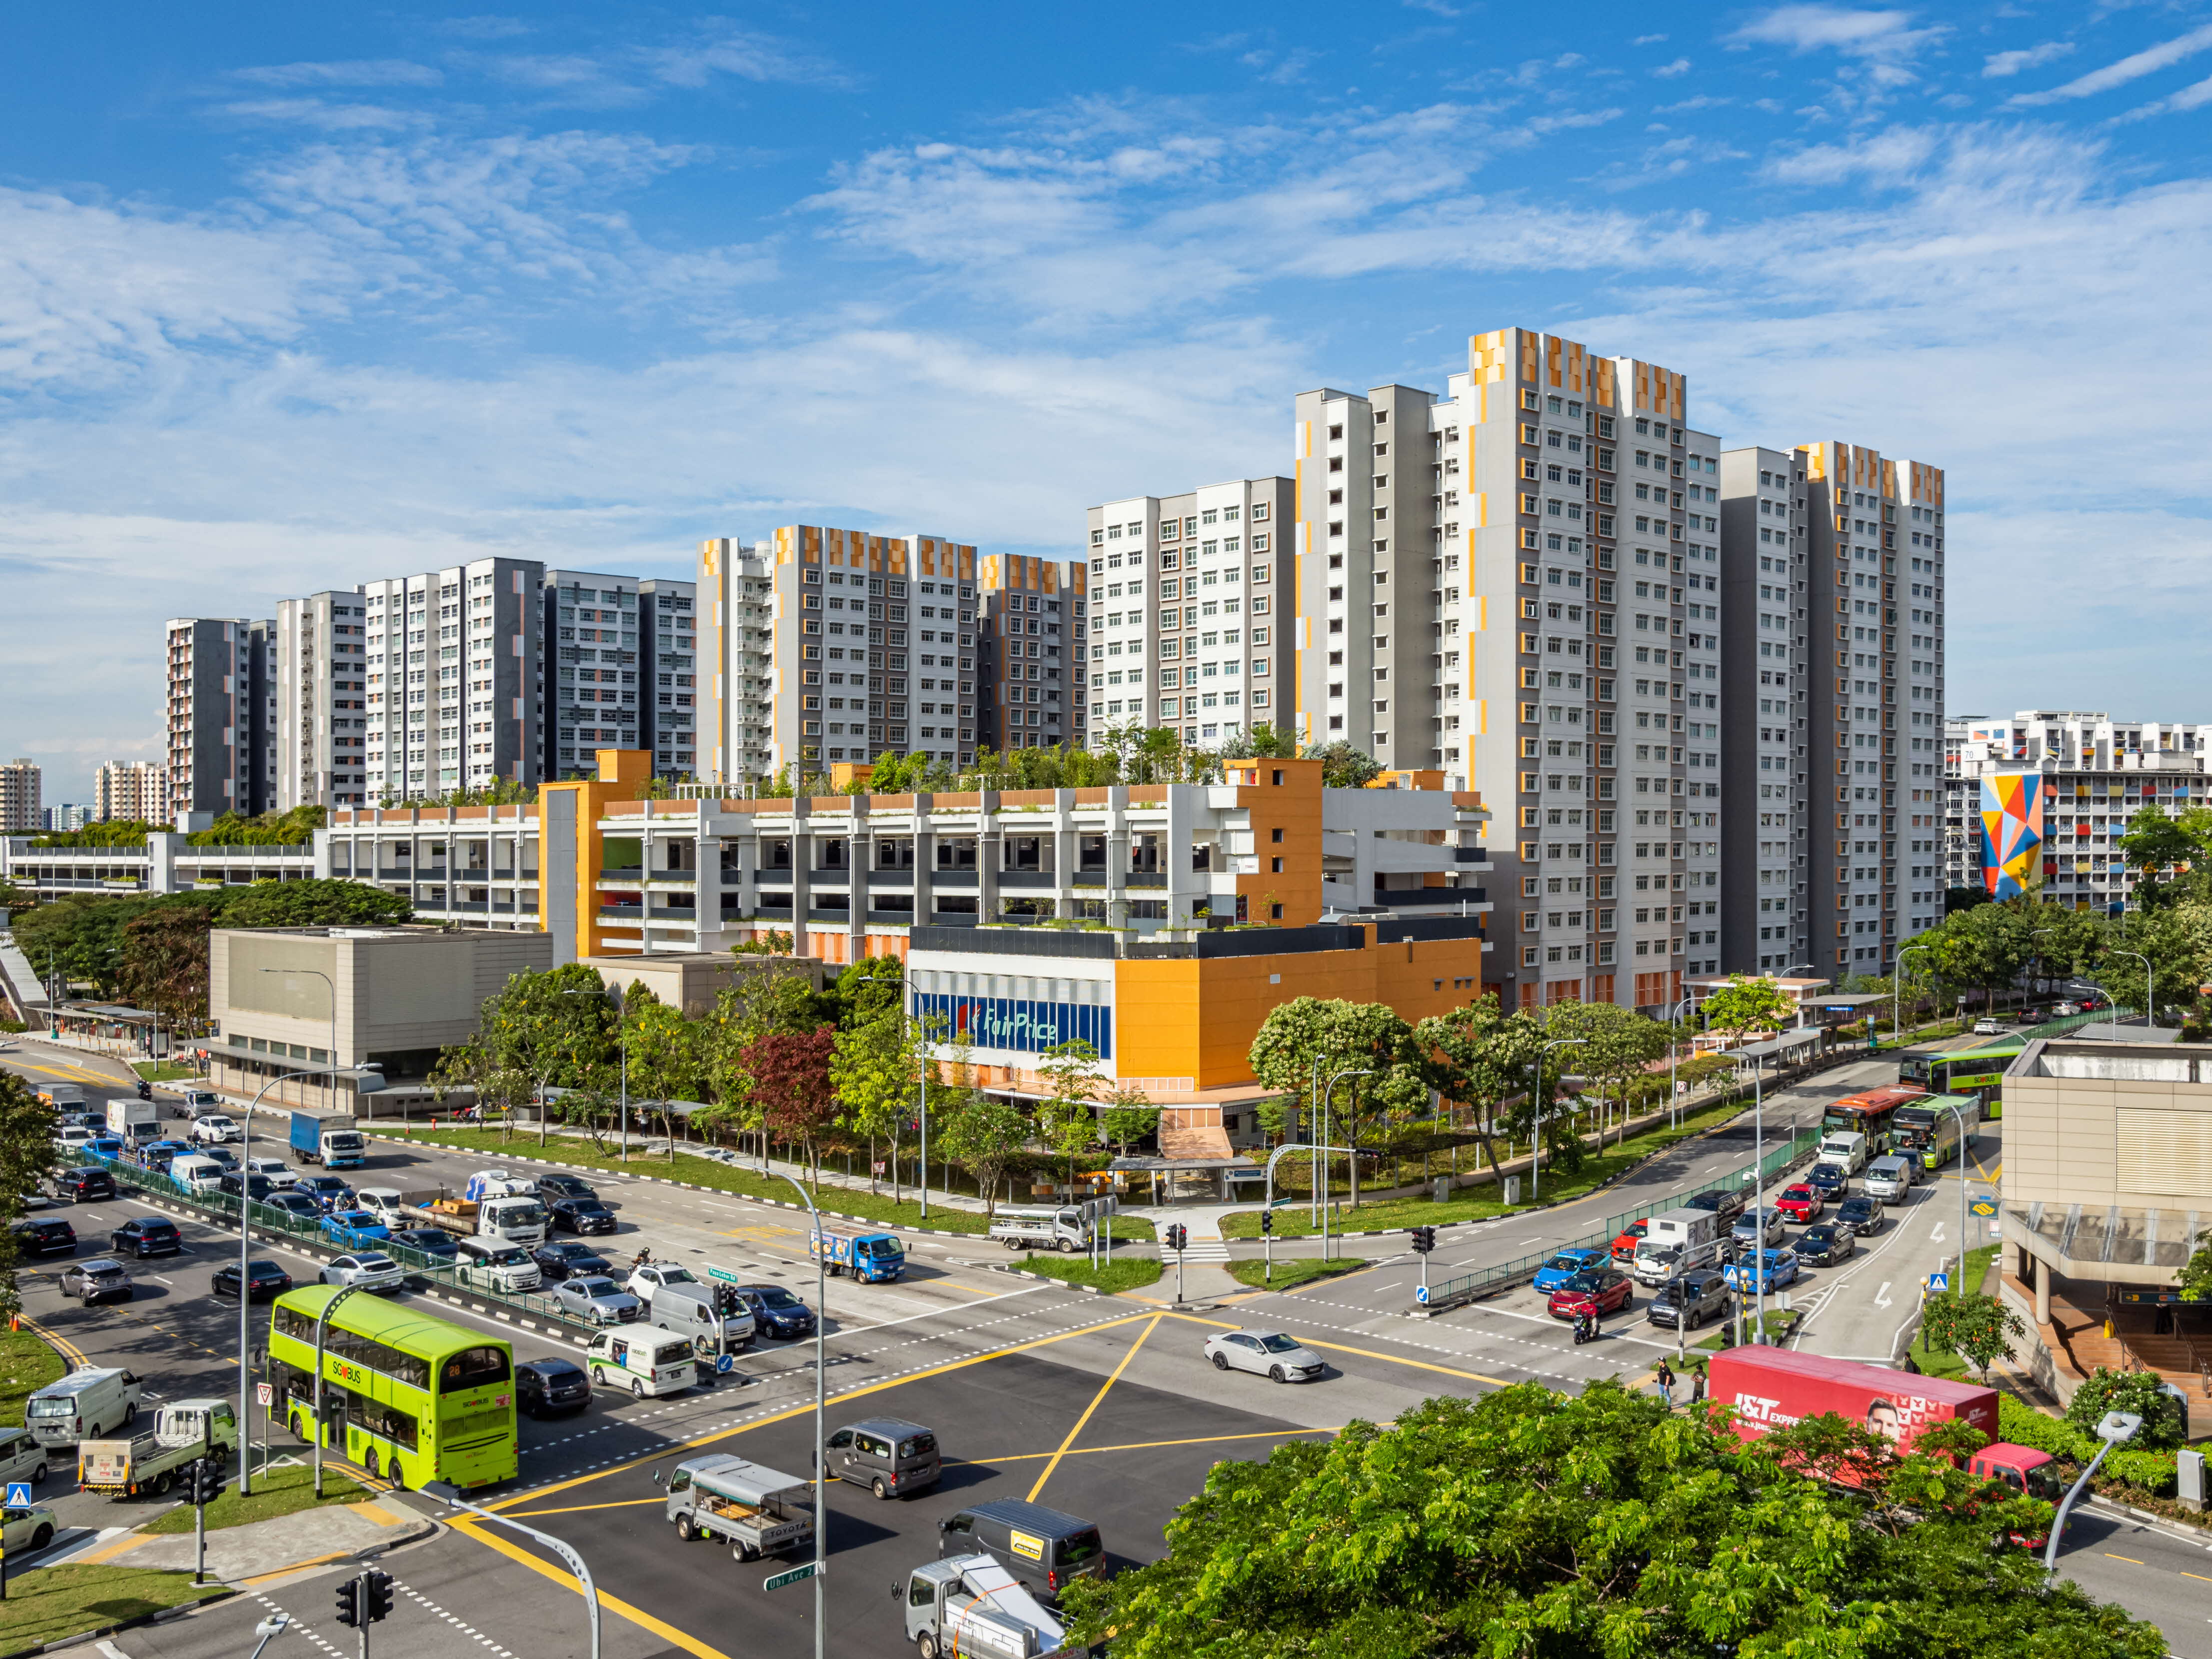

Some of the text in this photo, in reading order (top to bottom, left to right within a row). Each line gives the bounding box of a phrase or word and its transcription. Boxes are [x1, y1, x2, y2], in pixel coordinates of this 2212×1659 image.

[984, 1008, 1056, 1040] FairPrice
[449, 1365, 460, 1376] 28
[770, 1521, 808, 1537] TOYOTA
[770, 1567, 812, 1589] Ubi Ave 2
